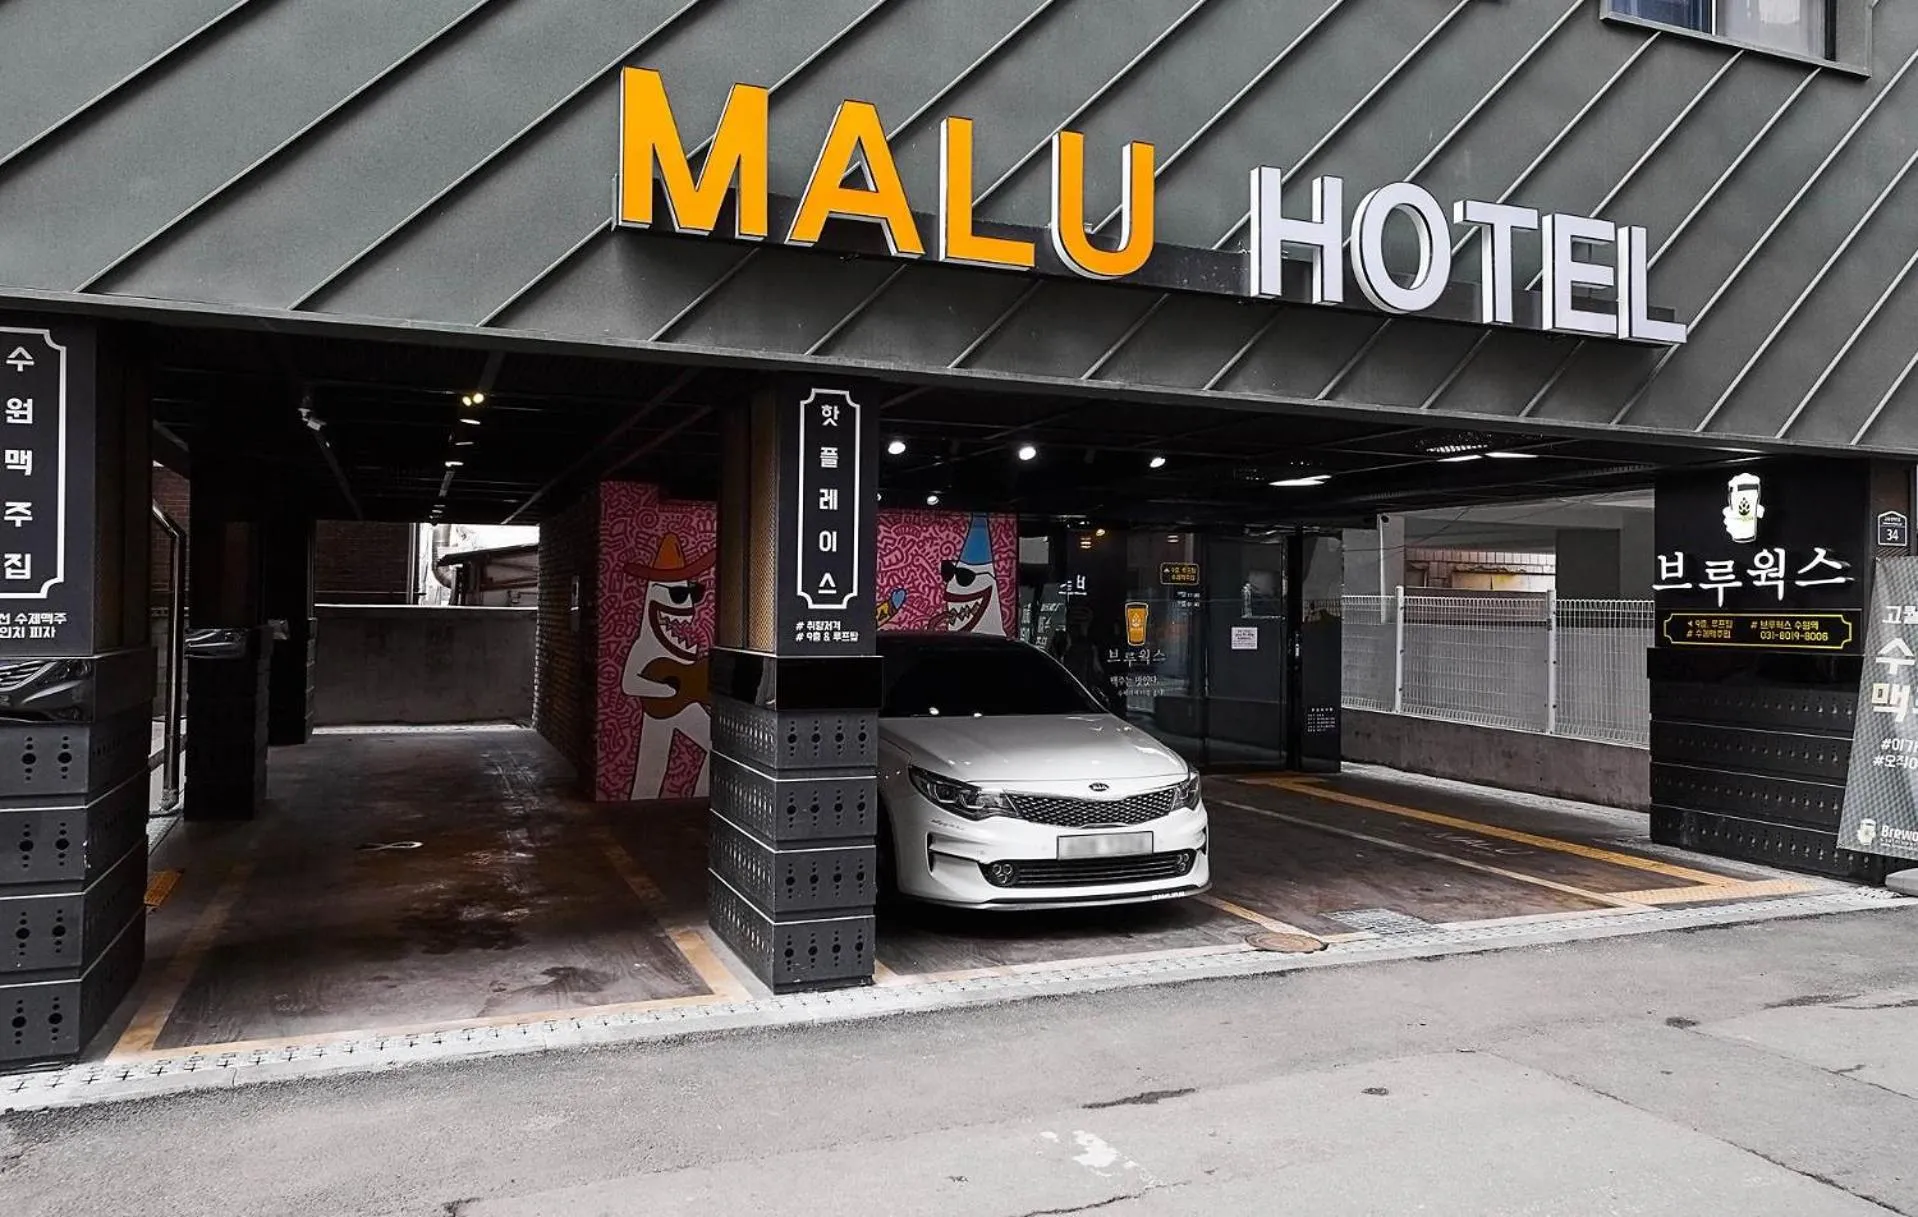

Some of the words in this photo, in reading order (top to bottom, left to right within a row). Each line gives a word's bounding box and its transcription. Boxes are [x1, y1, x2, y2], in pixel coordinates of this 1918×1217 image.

[618, 65, 1155, 280] MALU
[1250, 165, 1688, 345] HOTEL
[4, 346, 34, 580] 수원맥주집
[818, 404, 840, 594] 핫플레이스
[1886, 528, 1899, 541] 34
[1652, 547, 1855, 607] 브루웍스
[29, 625, 56, 639] 피자
[1871, 682, 1918, 722] 맥
